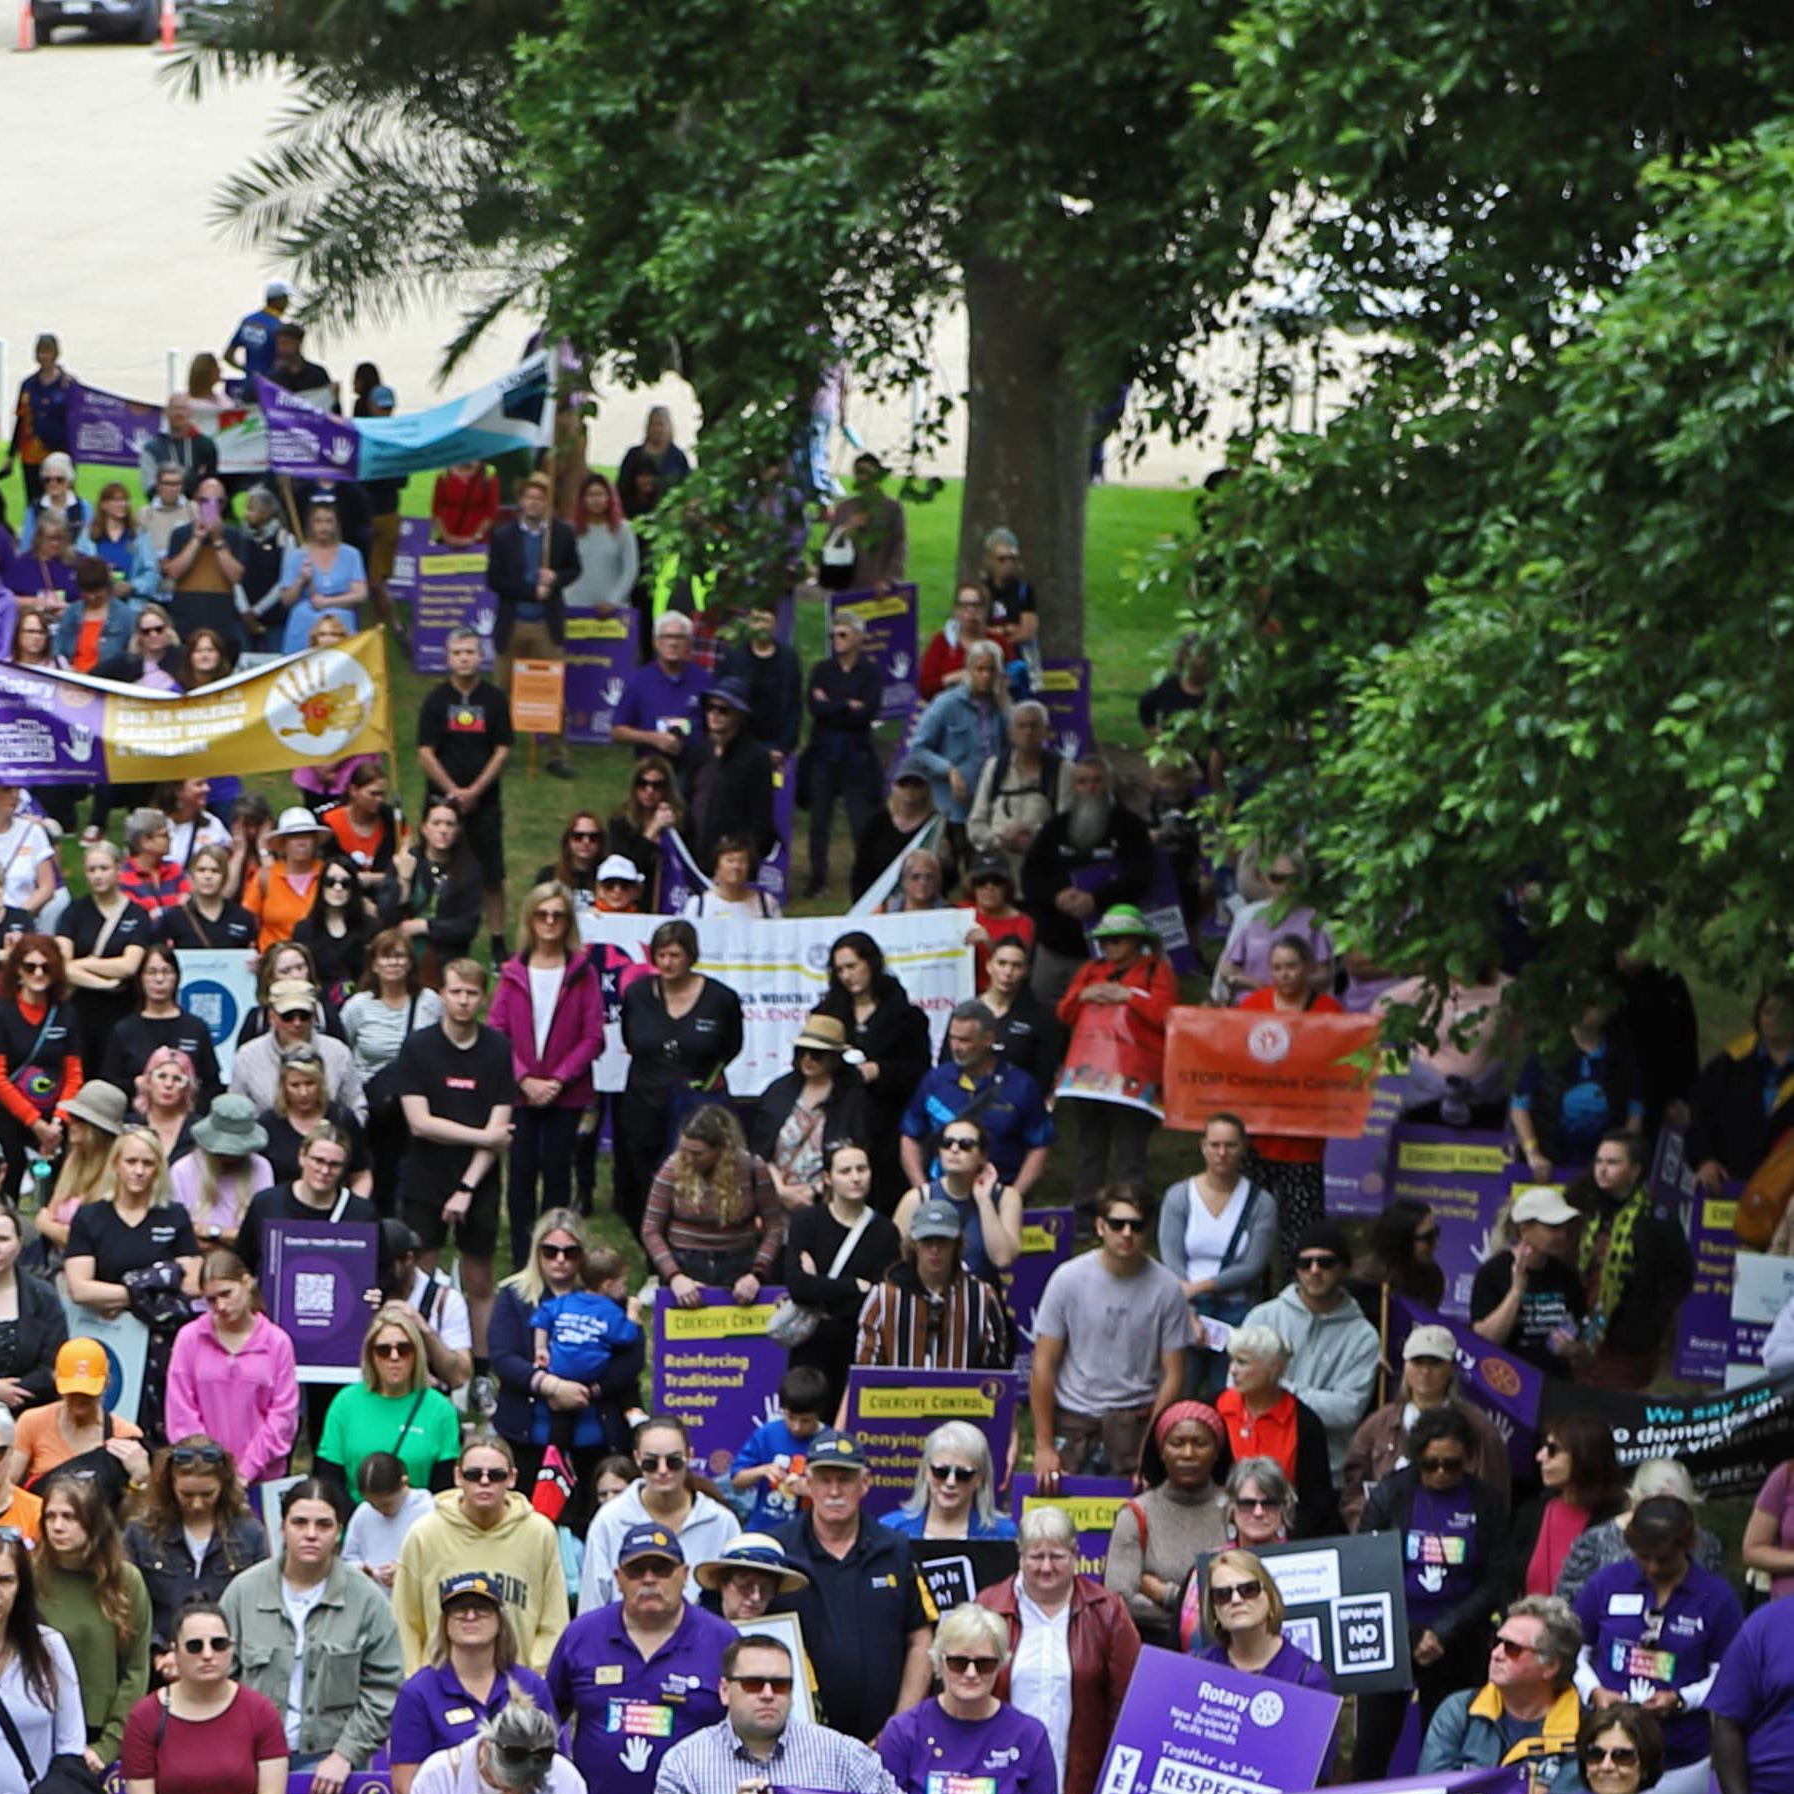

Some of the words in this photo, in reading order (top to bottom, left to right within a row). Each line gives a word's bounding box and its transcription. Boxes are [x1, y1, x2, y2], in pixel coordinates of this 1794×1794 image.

[664, 1353, 750, 1370] Reinforcing
[664, 1372, 745, 1388] Traditional
[664, 1393, 718, 1407] Gender
[869, 1394, 927, 1411] COERCIVE
[931, 1395, 984, 1410] CONTROL
[1645, 1405, 1685, 1424] We
[1691, 1400, 1736, 1421] say
[857, 1431, 928, 1450] Denying
[1347, 1624, 1379, 1645] NO
[1198, 1680, 1250, 1713] Rotary
[1170, 1705, 1192, 1722] New
[1193, 1712, 1231, 1732] Zealand
[1172, 1719, 1203, 1737] Pacific
[1204, 1726, 1237, 1746] Islands
[1161, 1741, 1217, 1766] Together
[1240, 1765, 1263, 1783] say
